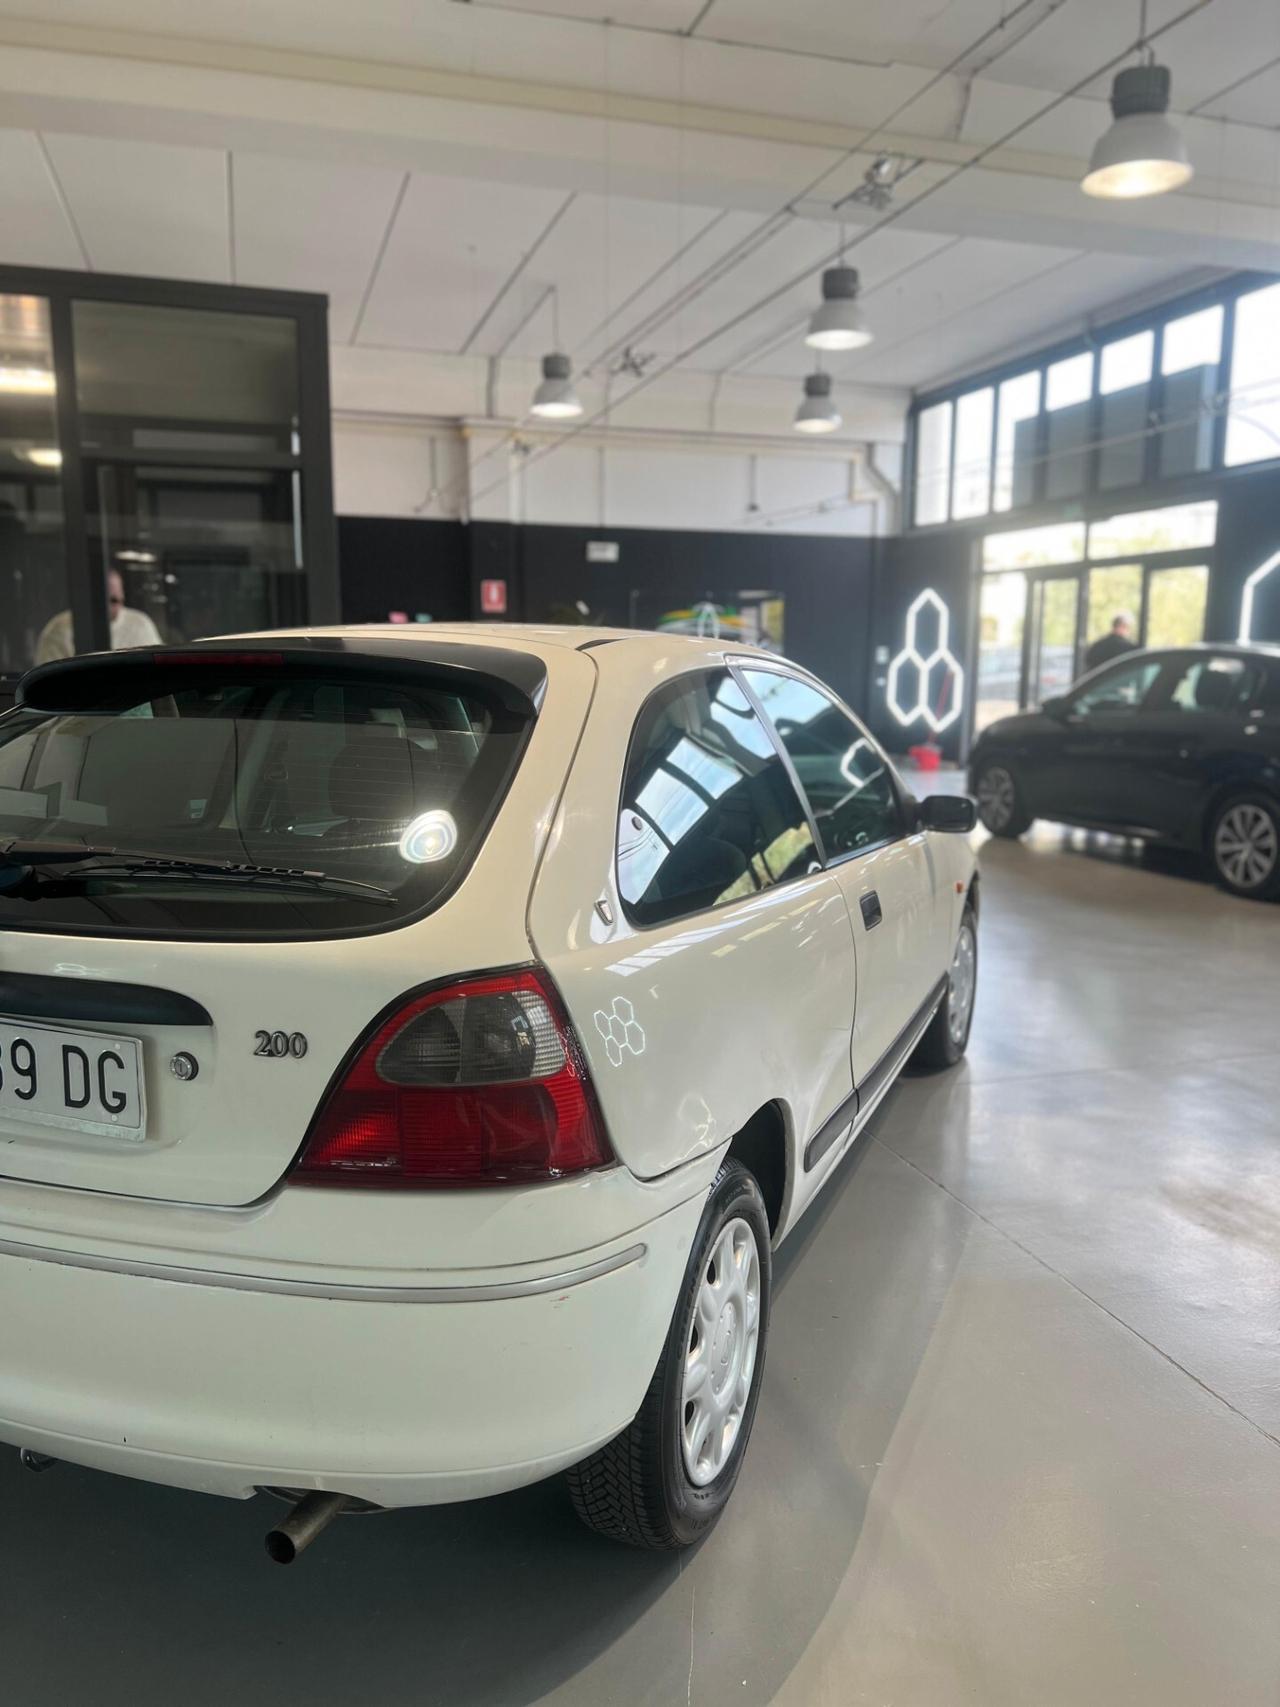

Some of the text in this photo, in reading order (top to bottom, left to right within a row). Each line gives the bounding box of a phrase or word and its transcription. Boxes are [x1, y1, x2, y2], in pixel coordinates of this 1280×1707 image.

[253, 1029, 308, 1059] 200
[0, 1038, 127, 1114] 9 DG
